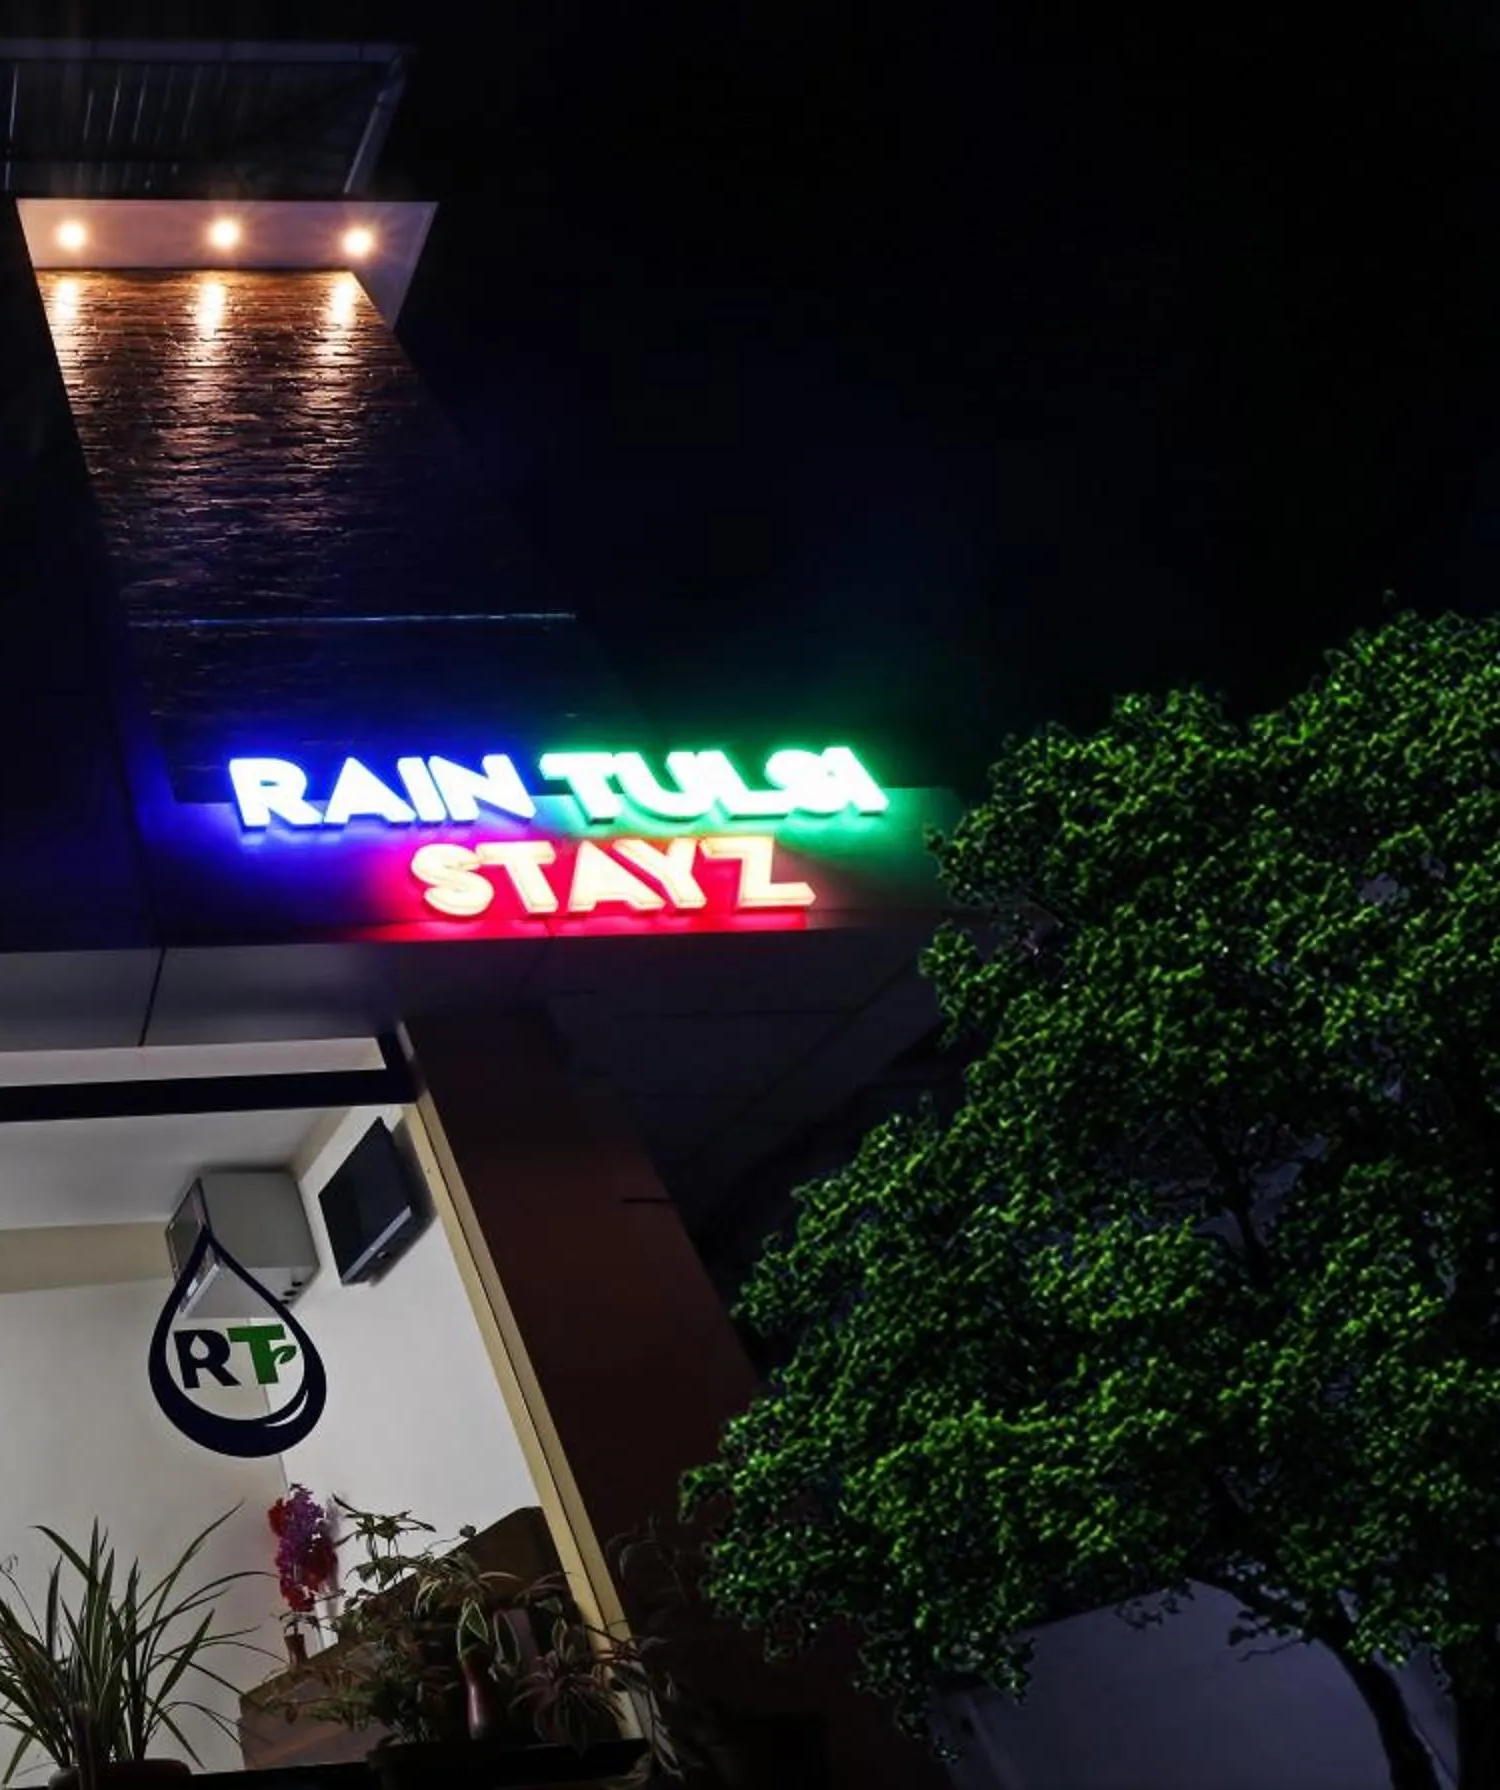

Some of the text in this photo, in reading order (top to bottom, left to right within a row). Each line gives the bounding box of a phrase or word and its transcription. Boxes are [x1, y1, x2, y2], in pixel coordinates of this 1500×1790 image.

[228, 746, 890, 828] RAIN TULSI
[411, 835, 817, 917] STAYZ
[173, 1324, 296, 1388] RT
